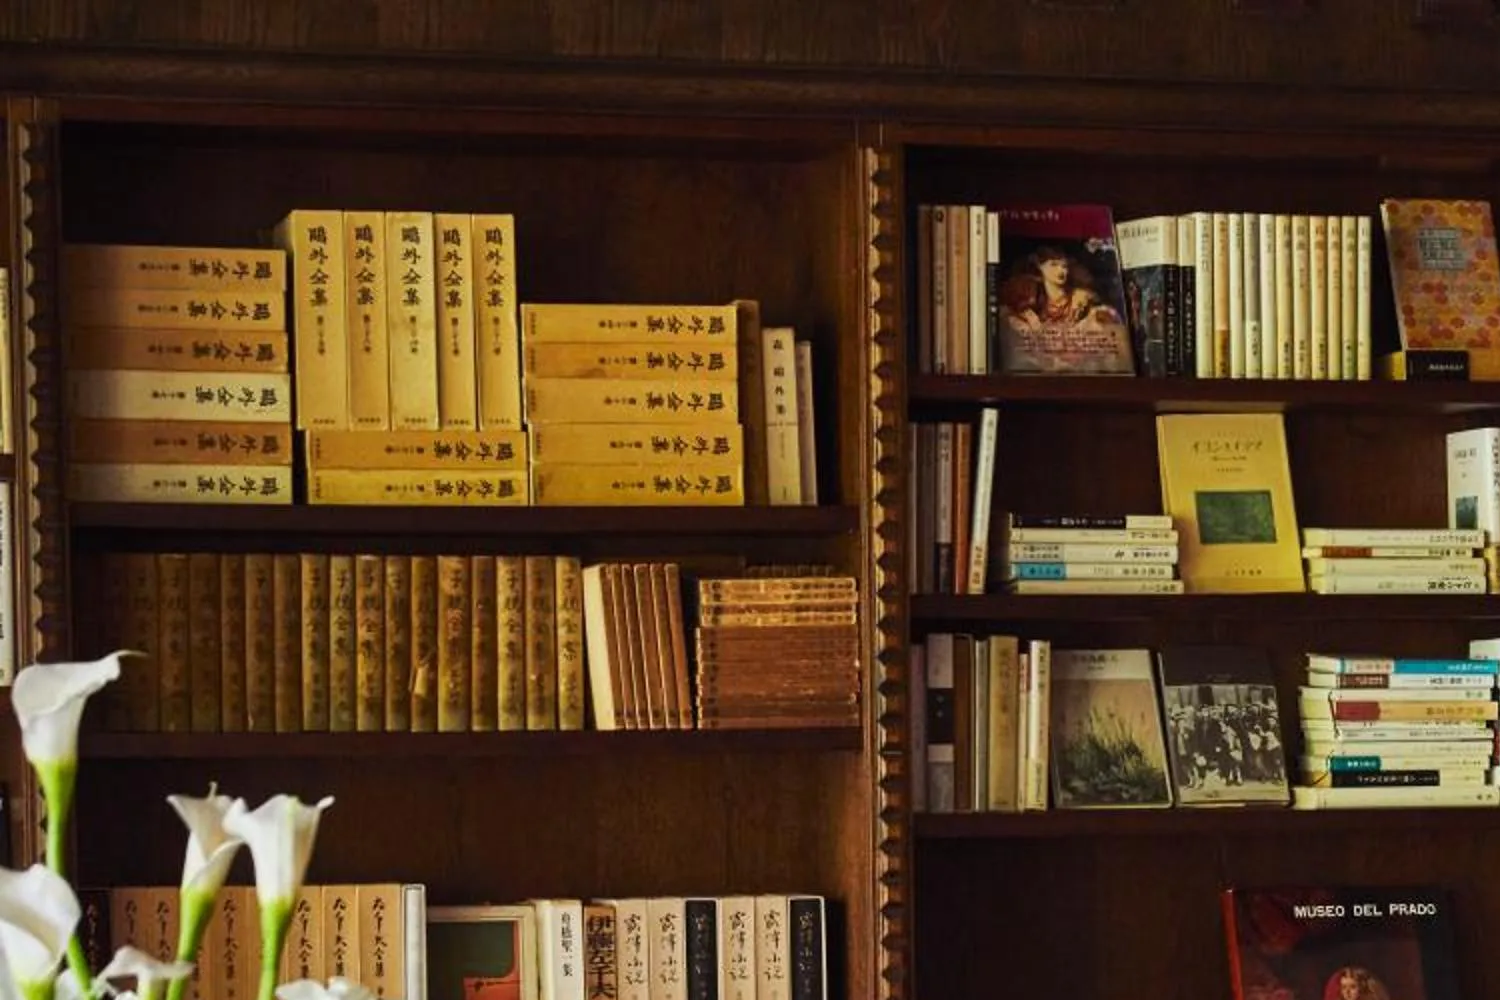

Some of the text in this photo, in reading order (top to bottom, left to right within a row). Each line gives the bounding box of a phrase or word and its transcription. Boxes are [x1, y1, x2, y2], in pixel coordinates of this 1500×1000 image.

[1293, 903, 1437, 918] MUSEO DEL PRADO
